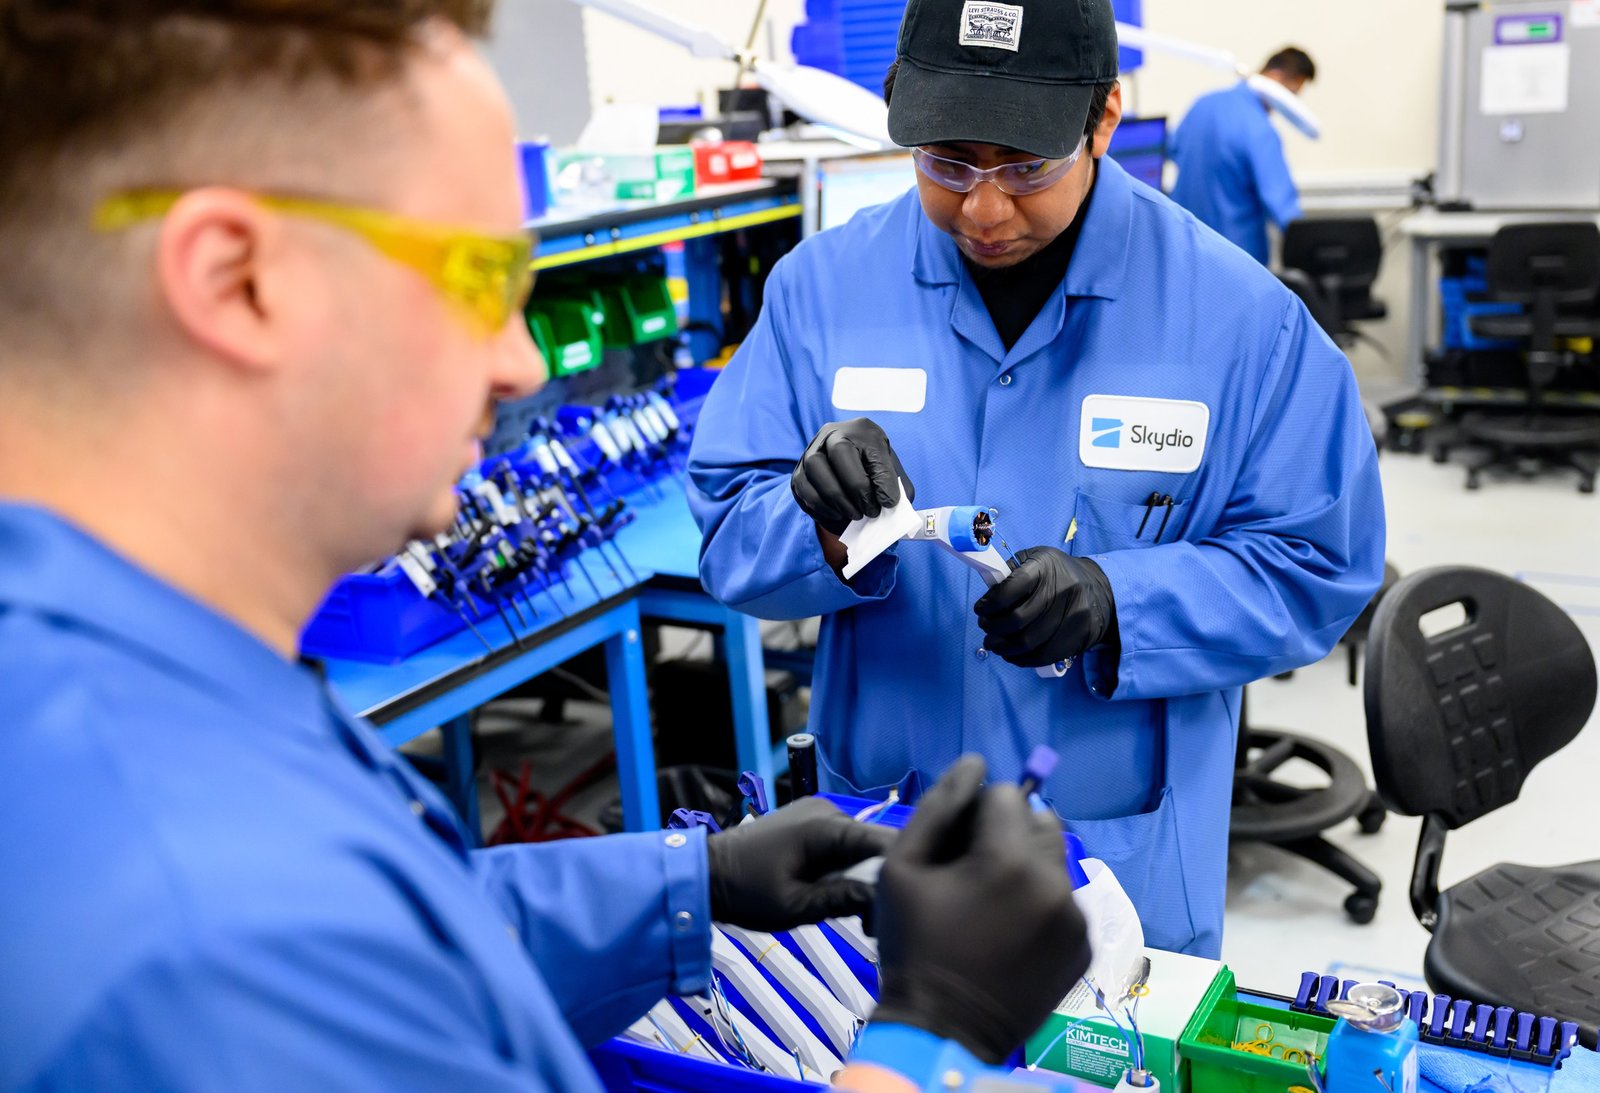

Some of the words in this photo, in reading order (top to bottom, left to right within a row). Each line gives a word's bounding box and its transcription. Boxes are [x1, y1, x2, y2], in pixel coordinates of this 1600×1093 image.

[981, 6, 1003, 15] STRAUSS
[1131, 424, 1193, 451] Skydio
[1066, 1028, 1129, 1051] KIMTECH
